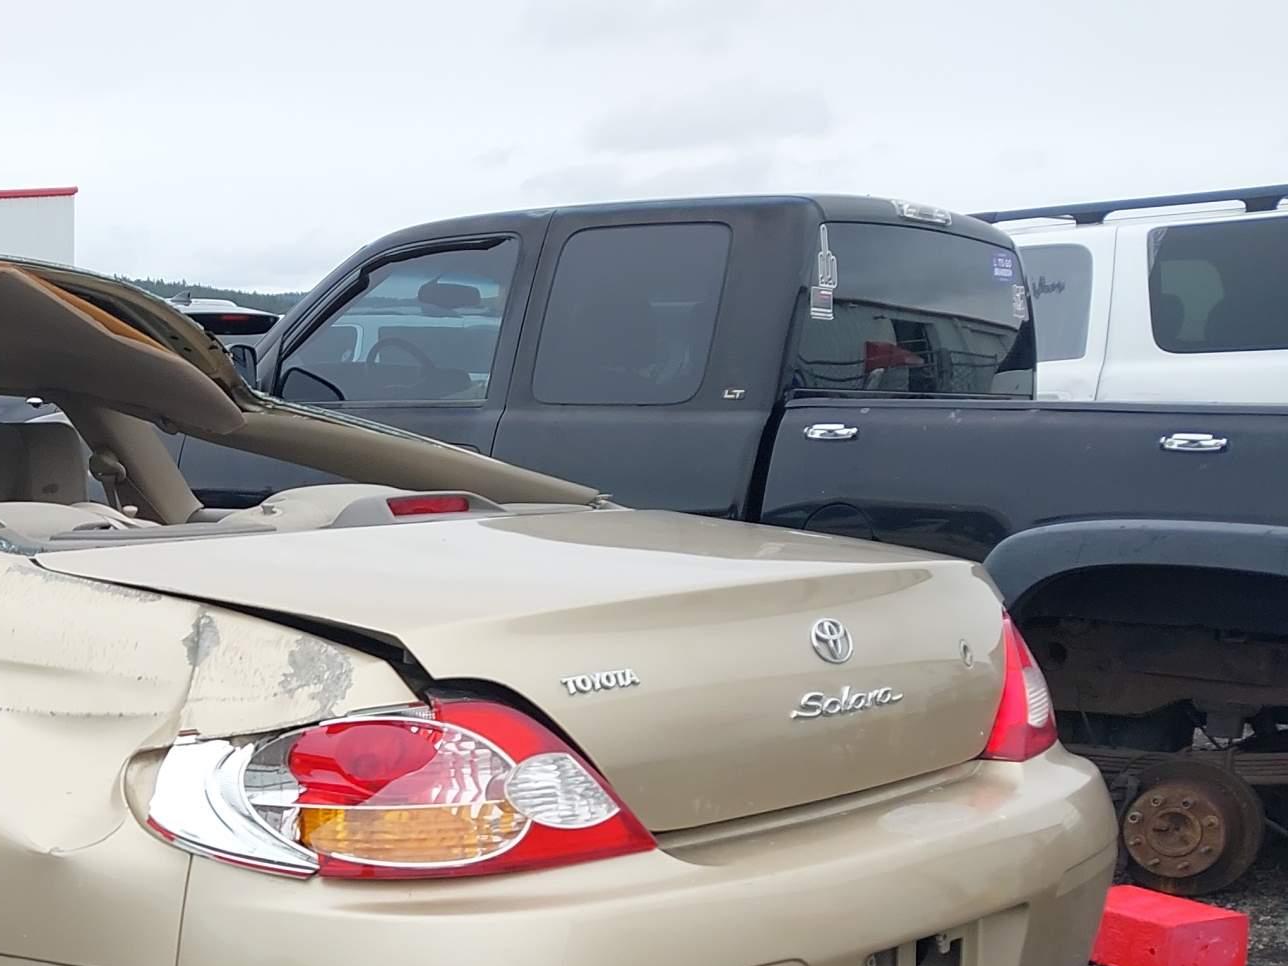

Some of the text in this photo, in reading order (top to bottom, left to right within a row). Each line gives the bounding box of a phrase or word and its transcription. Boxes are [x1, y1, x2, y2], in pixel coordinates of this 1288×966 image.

[724, 389, 745, 399] LT
[560, 668, 640, 695] TOYOTA
[790, 685, 903, 719] Solara
